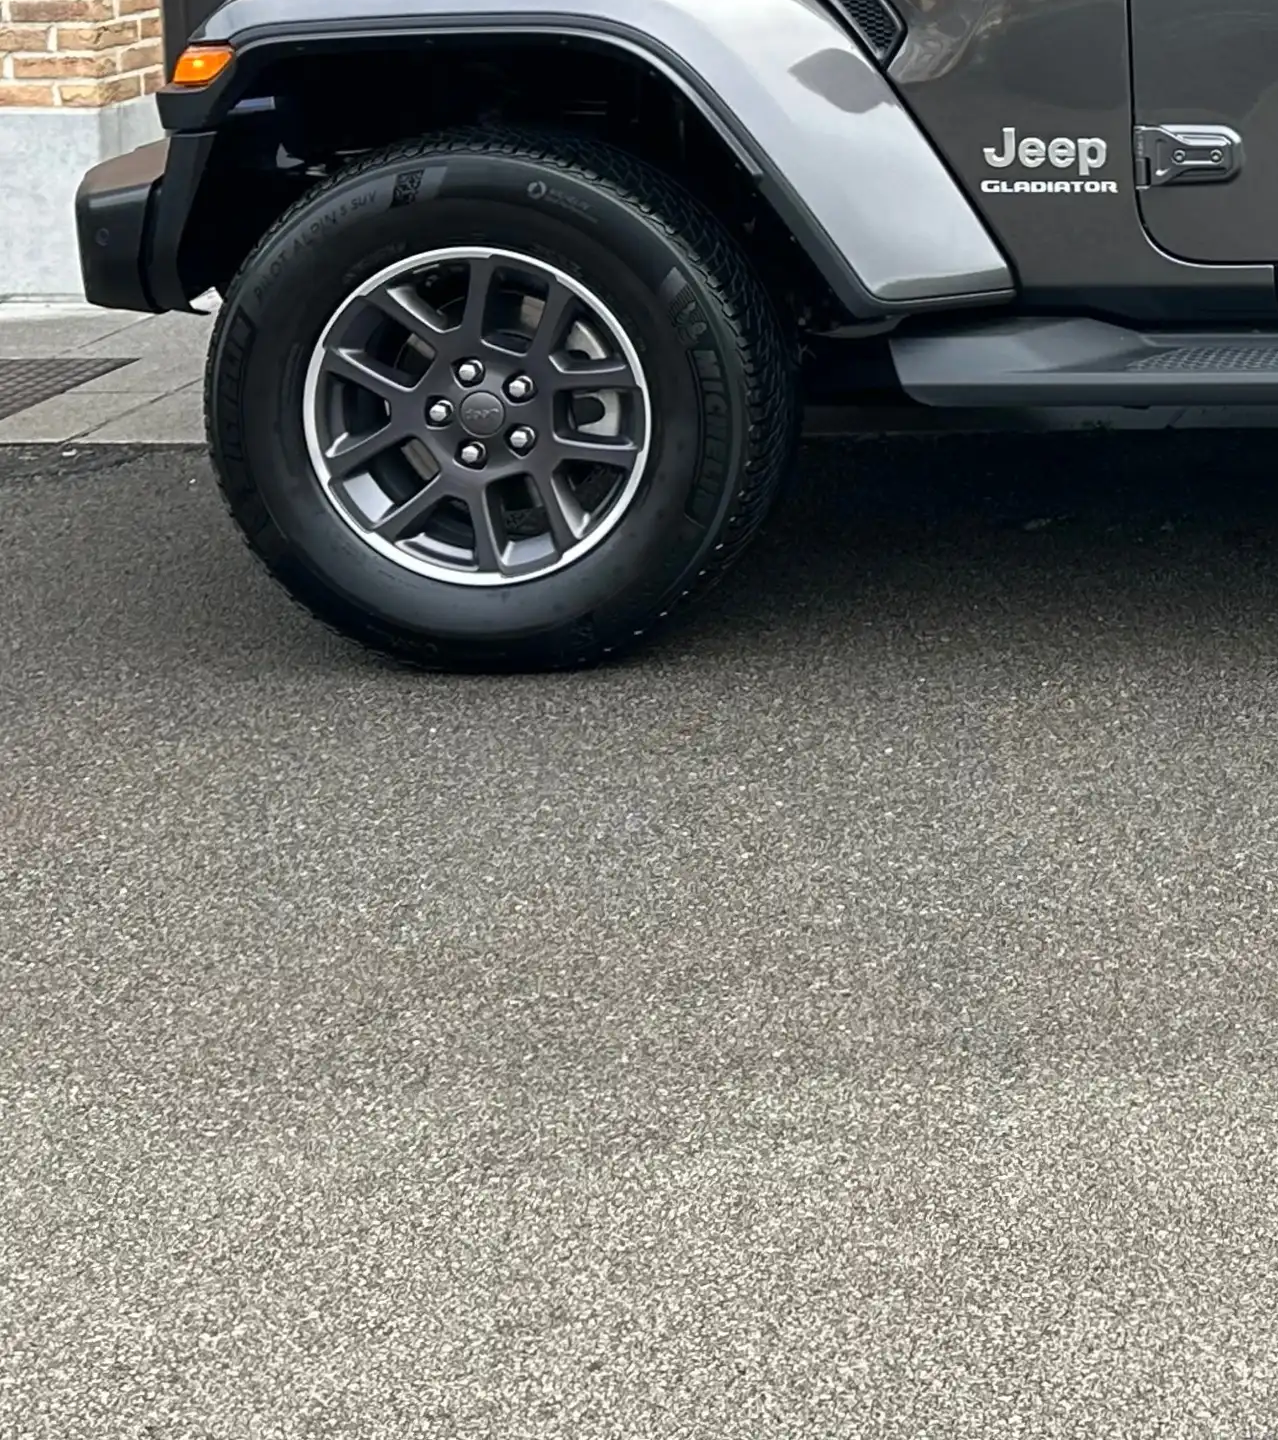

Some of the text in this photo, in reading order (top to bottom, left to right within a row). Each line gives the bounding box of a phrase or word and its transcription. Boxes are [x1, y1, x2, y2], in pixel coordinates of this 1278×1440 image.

[983, 127, 1107, 176] Jeep
[980, 179, 1118, 194] GLADIATOR
[350, 190, 377, 211] SUV
